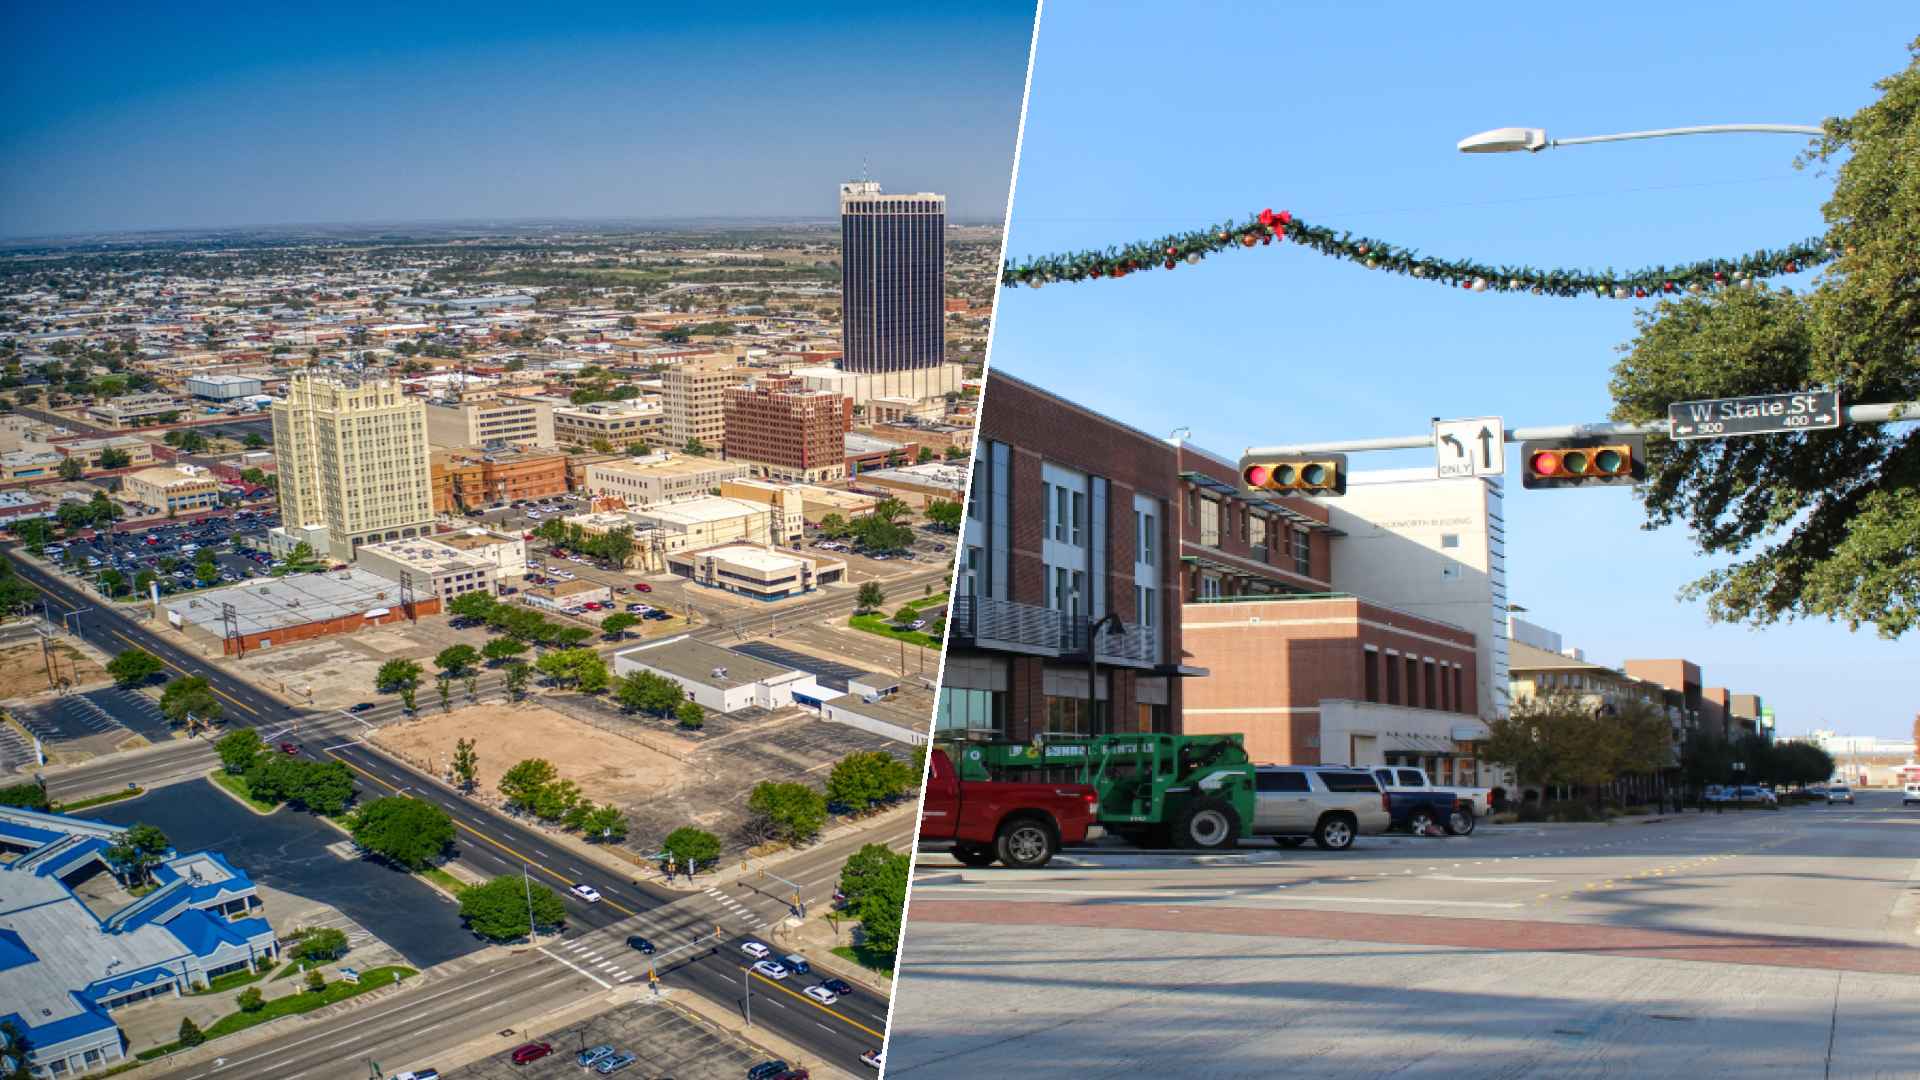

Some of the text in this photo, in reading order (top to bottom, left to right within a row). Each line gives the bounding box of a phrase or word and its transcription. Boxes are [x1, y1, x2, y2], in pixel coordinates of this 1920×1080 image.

[1690, 395, 1817, 422] W State St
[1783, 415, 1809, 426] 400
[1697, 422, 1724, 434] 500
[1440, 463, 1471, 475] ONLY
